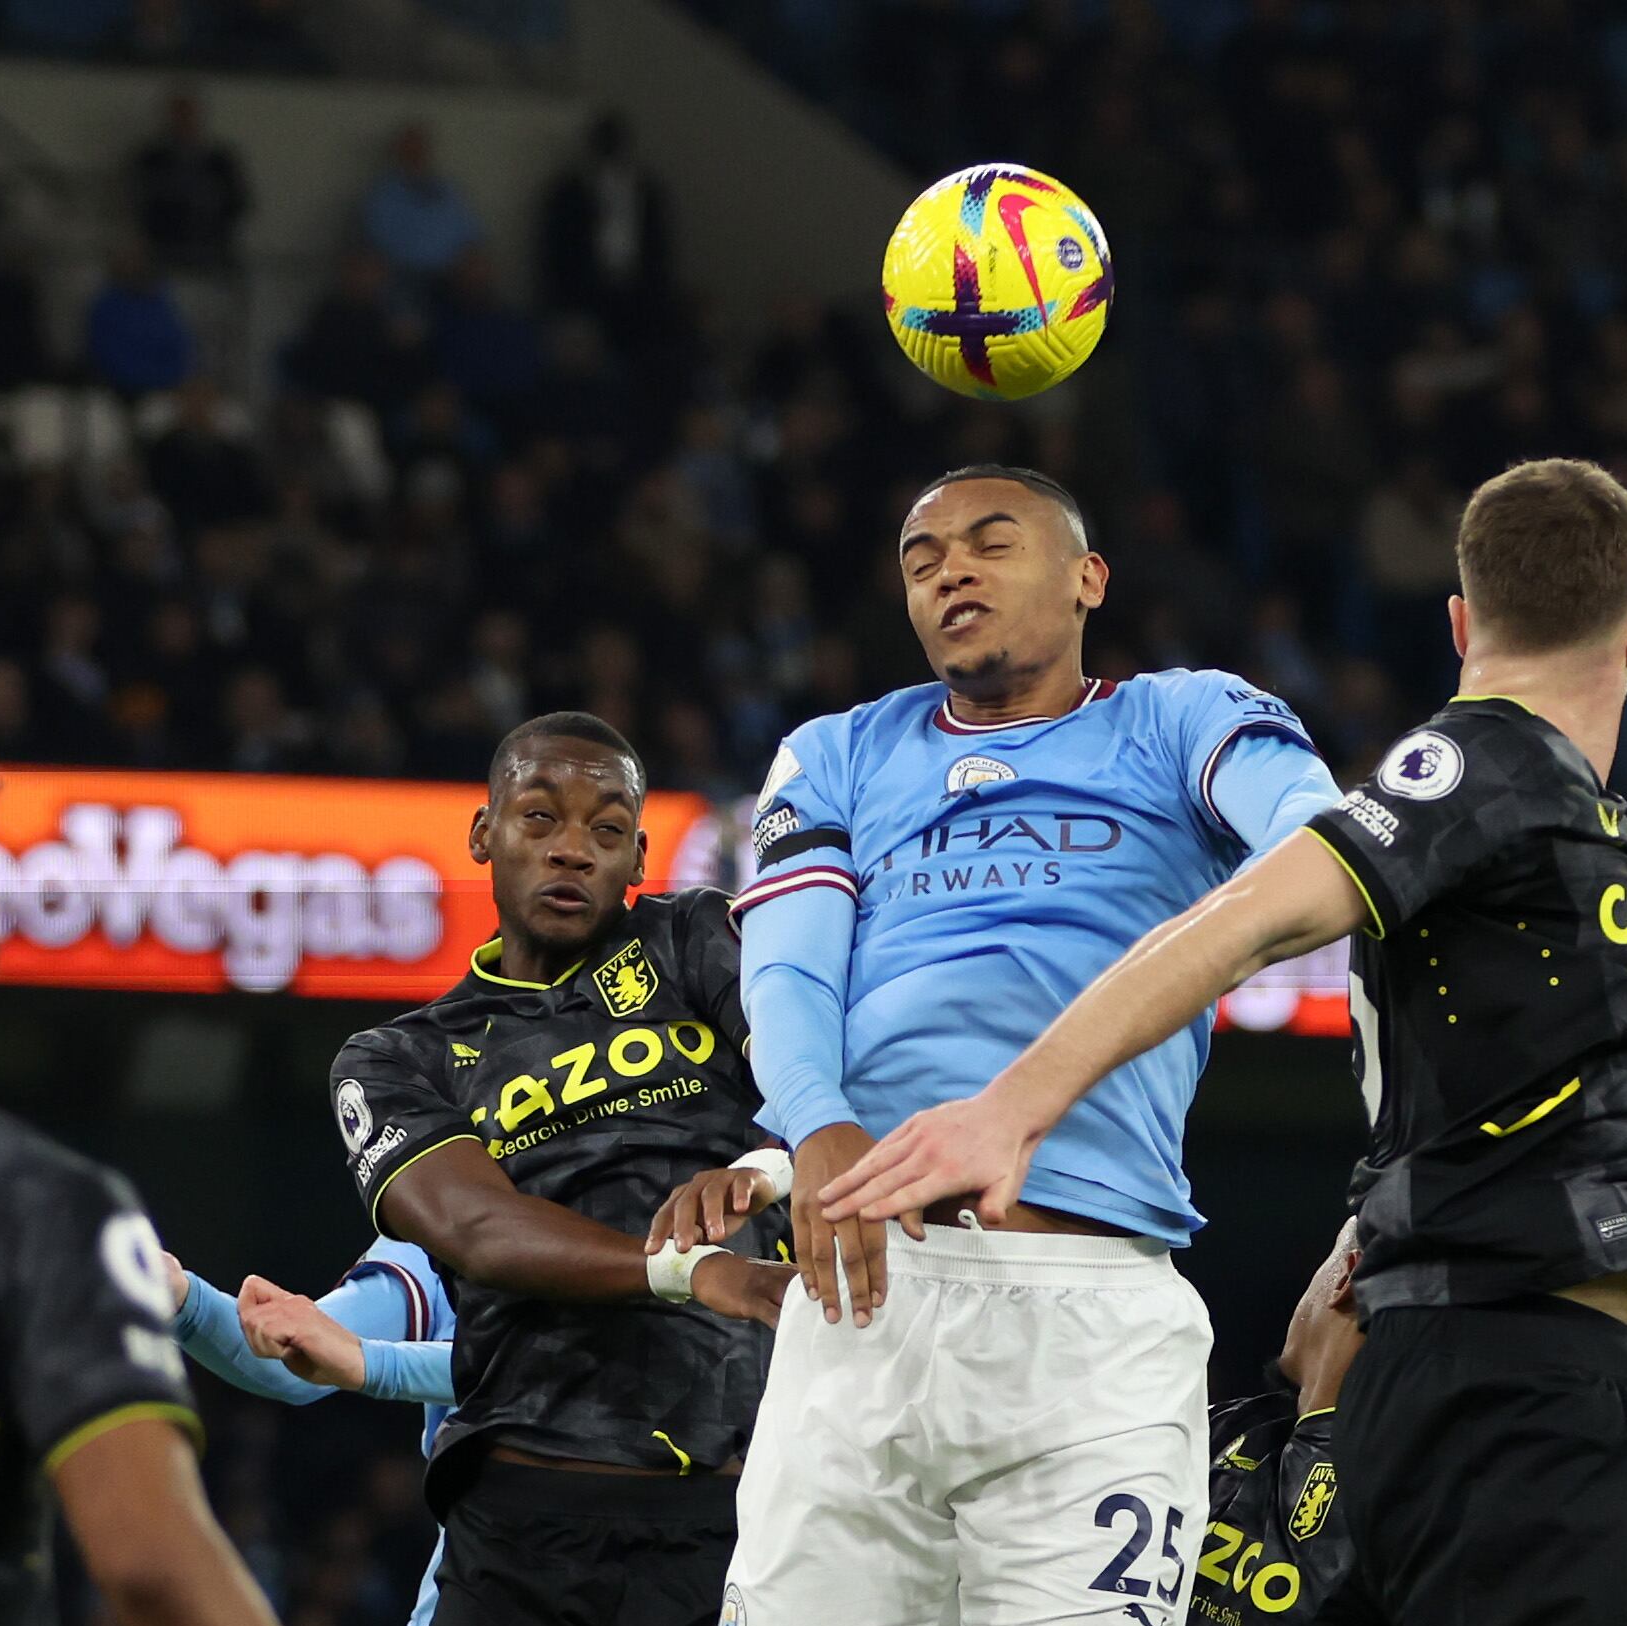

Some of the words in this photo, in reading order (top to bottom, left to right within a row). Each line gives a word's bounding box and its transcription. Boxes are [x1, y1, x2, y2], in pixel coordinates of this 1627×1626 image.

[887, 861, 1061, 902] RWAYS
[601, 944, 640, 983] AVFC
[638, 1076, 709, 1108] Smile.
[1087, 1492, 1185, 1607] 25
